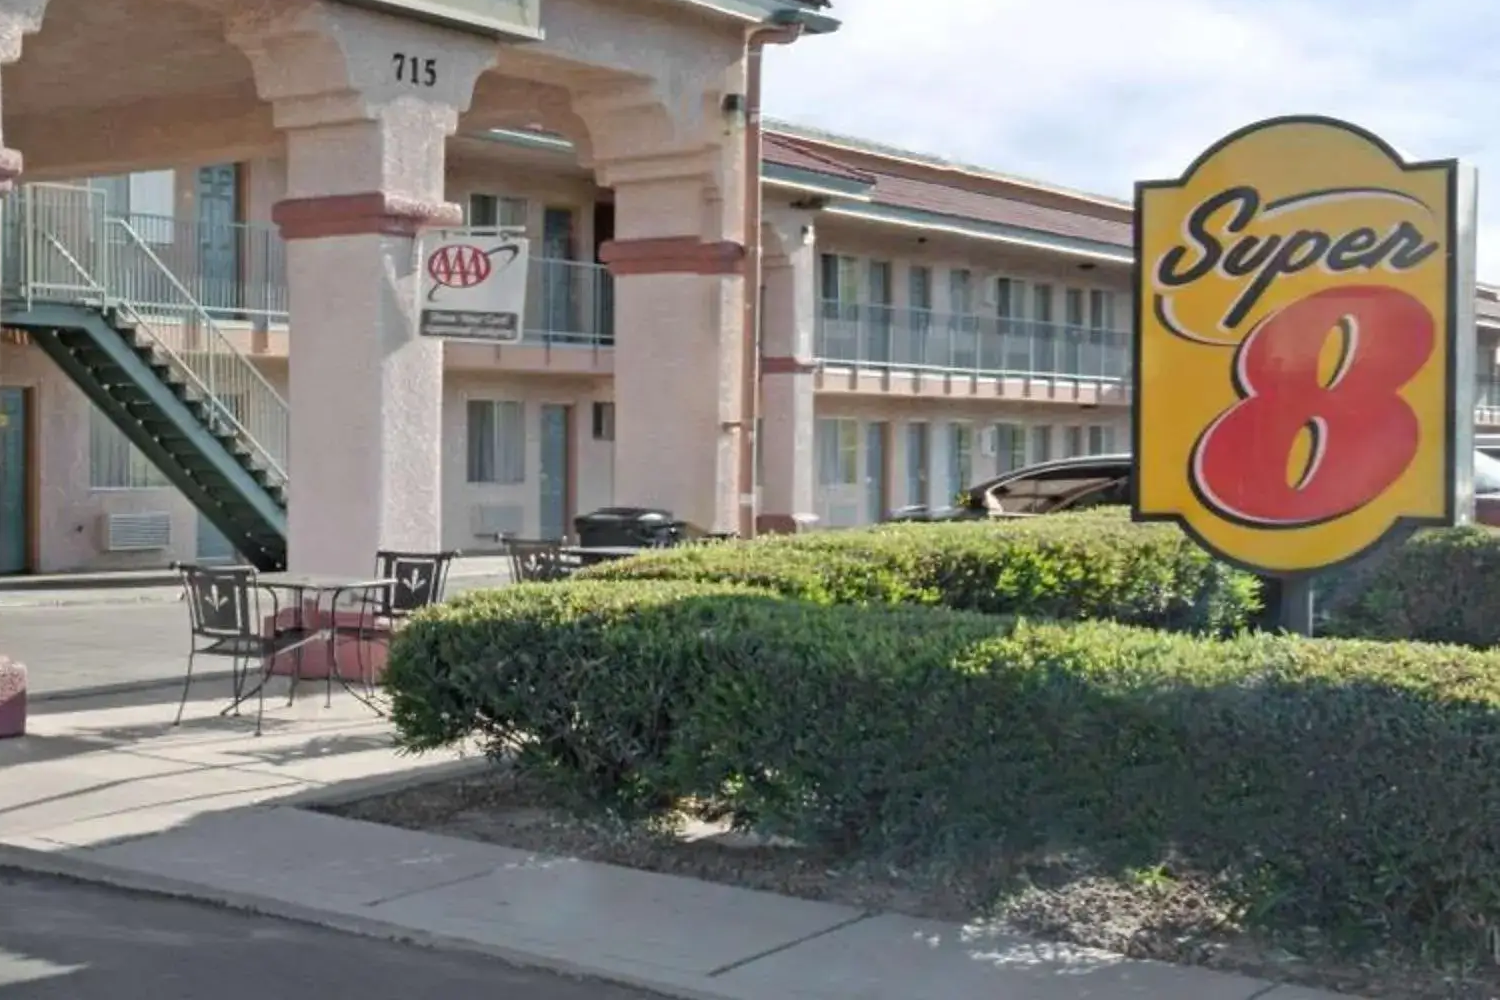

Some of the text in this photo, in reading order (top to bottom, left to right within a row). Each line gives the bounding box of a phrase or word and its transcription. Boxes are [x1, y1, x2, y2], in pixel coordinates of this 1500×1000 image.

[393, 53, 437, 87] 715
[432, 245, 487, 286] AAA
[1154, 185, 1441, 330] Super
[1187, 285, 1436, 528] 8
